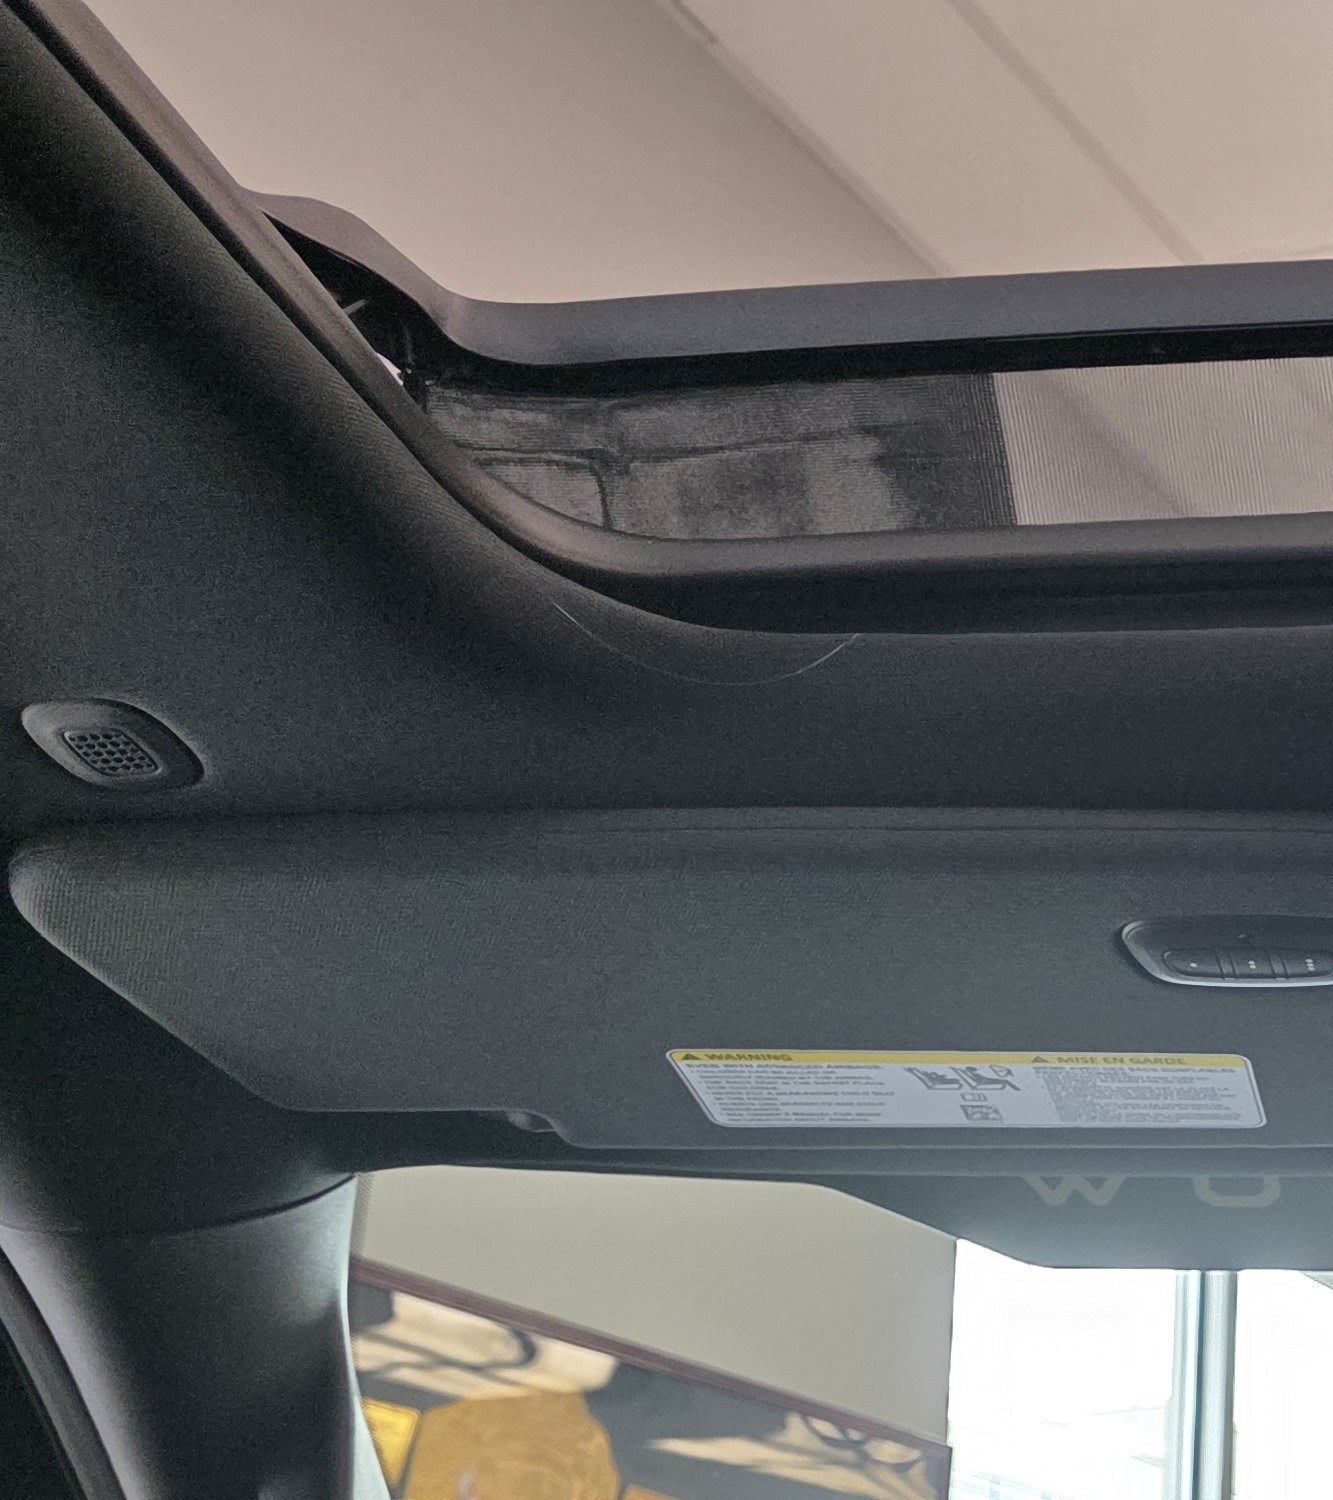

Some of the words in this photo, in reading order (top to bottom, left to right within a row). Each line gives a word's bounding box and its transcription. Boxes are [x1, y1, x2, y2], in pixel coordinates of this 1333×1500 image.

[705, 1053, 792, 1062] WARNING
[1057, 1056, 1097, 1064] MISE
[1130, 1057, 1186, 1065] GARDE
